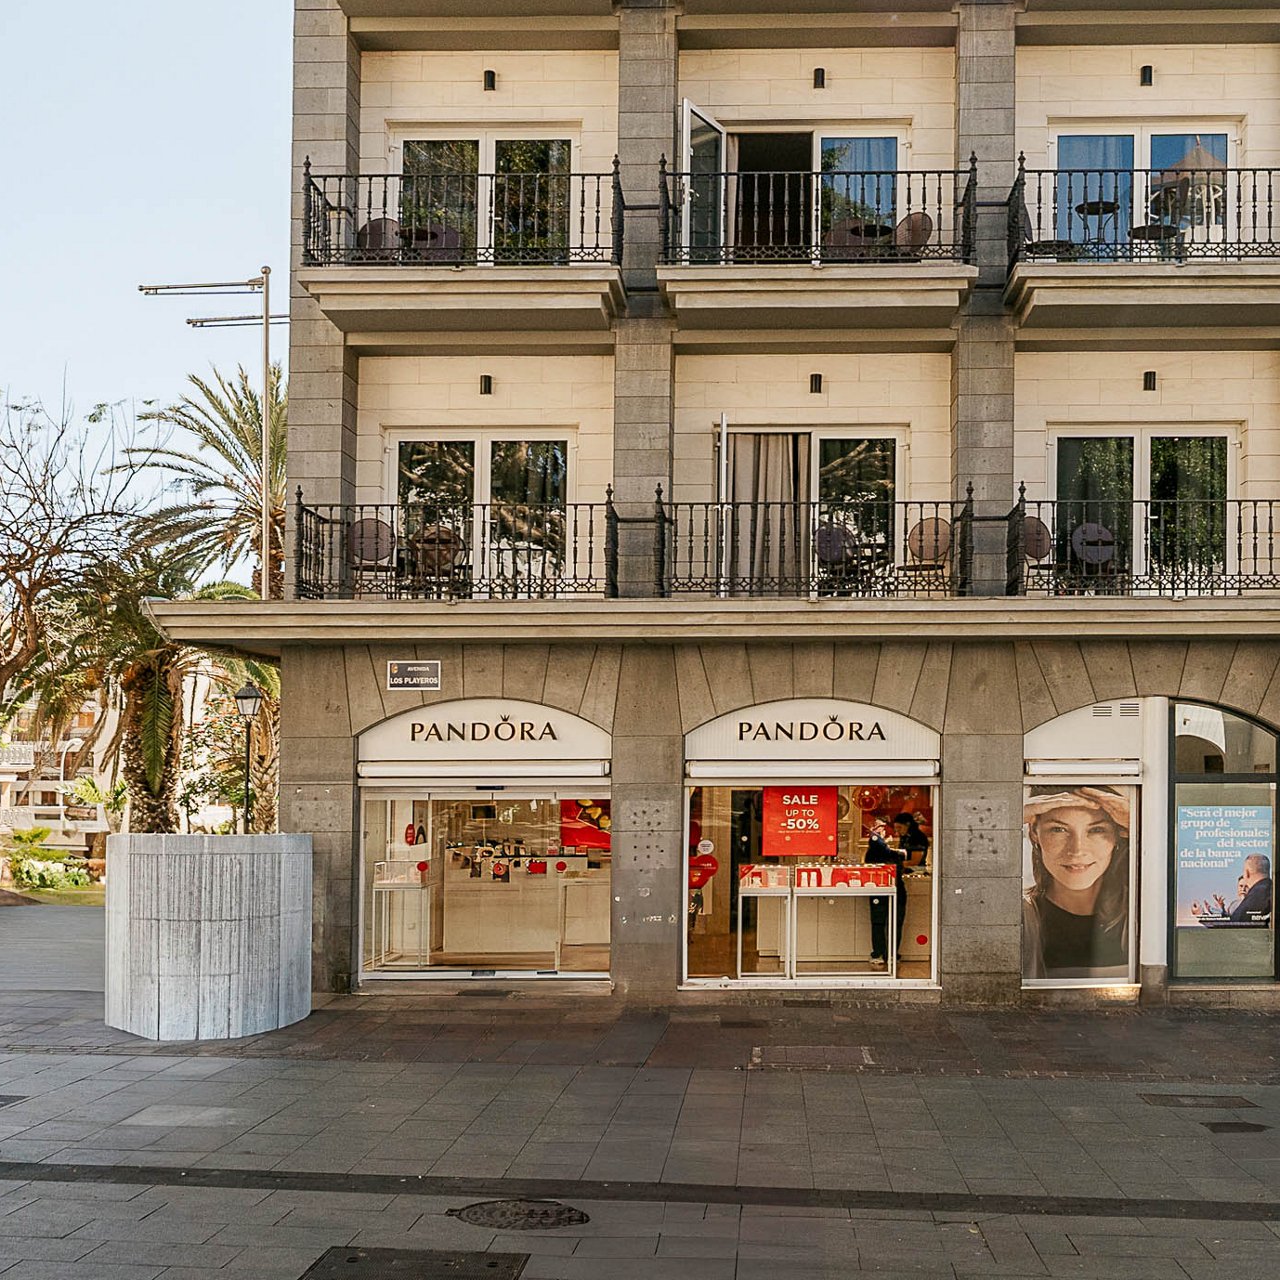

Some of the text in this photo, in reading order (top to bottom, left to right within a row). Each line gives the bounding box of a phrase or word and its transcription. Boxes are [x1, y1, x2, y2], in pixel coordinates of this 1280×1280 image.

[390, 677, 439, 685] LOS PLAYEROS
[410, 715, 558, 741] PANDORA
[738, 715, 886, 741] PANDORA
[782, 795, 819, 805] SALE
[785, 809, 815, 817] UP TO
[1213, 807, 1223, 818] el
[1224, 807, 1257, 820] mejor
[780, 818, 820, 830] -50%
[1181, 820, 1215, 830] grupo
[1216, 818, 1231, 828] de
[1195, 828, 1270, 839] profesionales
[1216, 838, 1270, 848] del sector
[1180, 848, 1241, 858] de la banca
